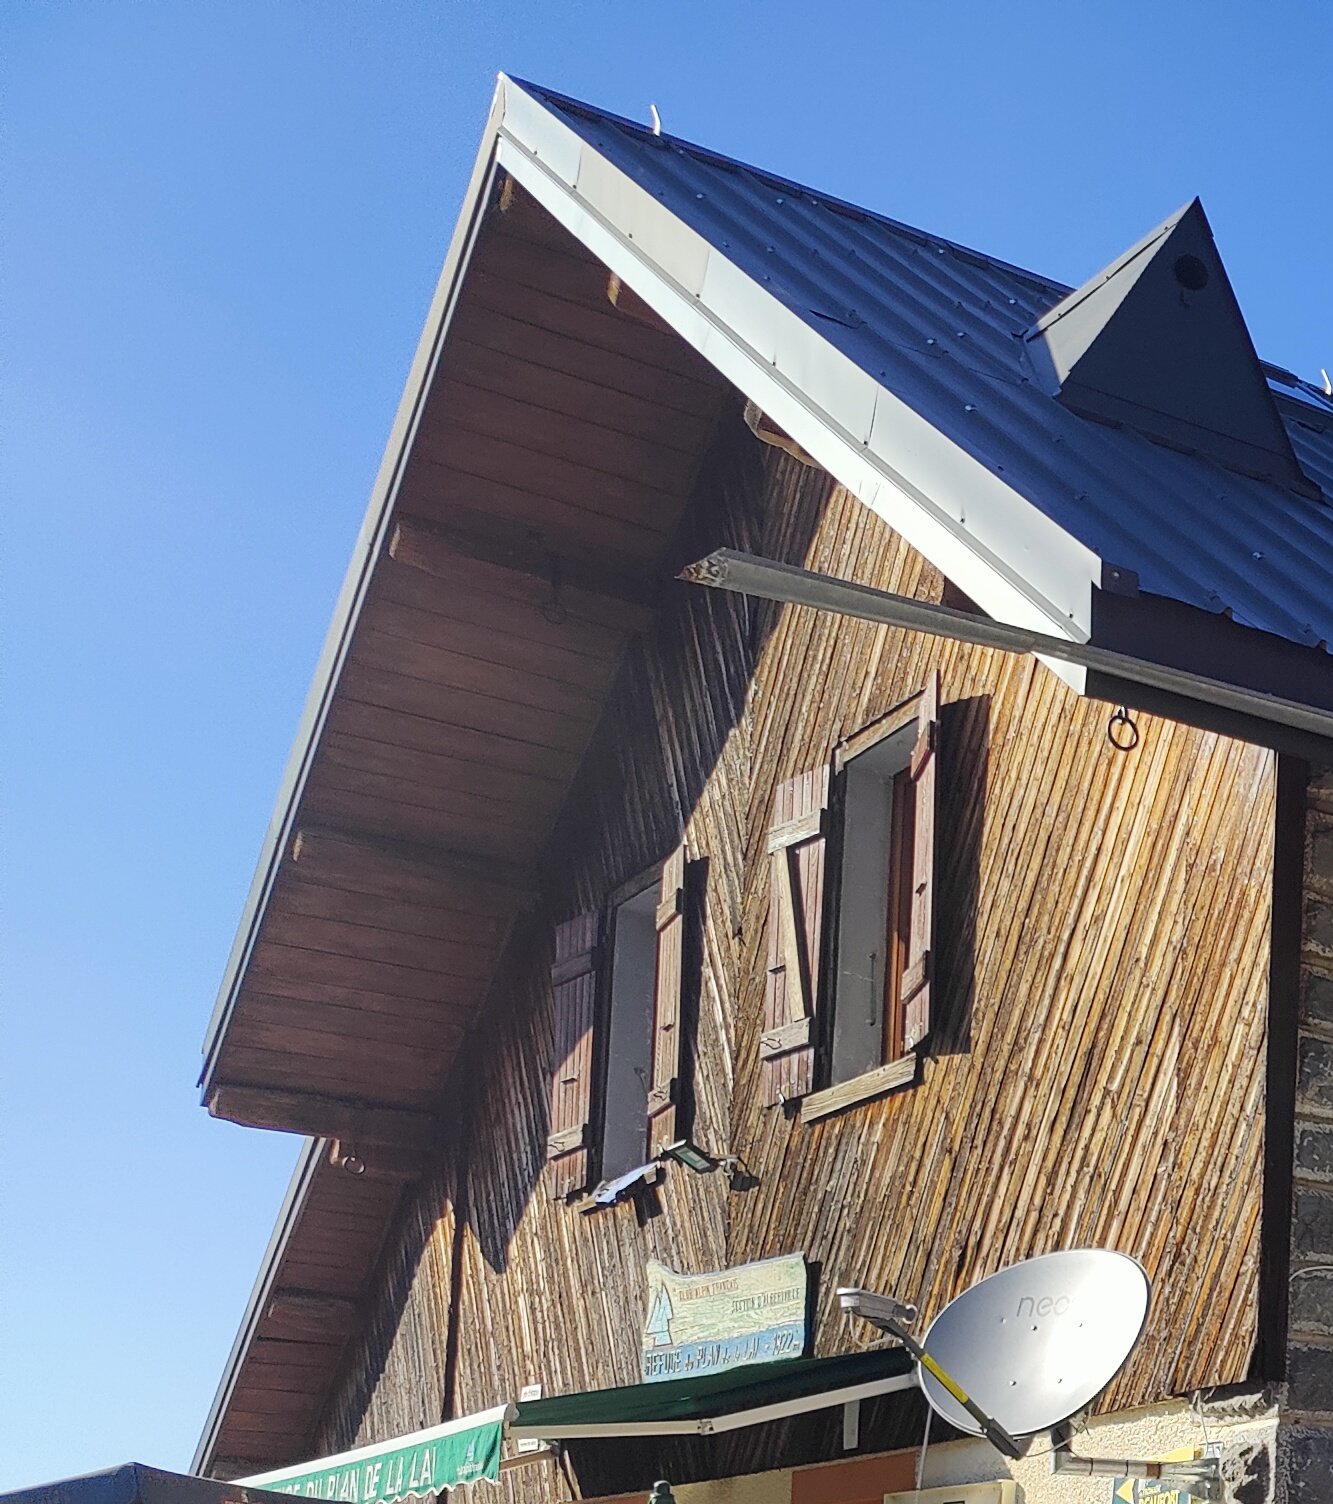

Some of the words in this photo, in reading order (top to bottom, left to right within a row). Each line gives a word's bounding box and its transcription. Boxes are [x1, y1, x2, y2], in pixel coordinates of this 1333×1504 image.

[644, 1350, 682, 1376] REFUGE
[697, 1343, 721, 1368] PLAN
[326, 1468, 359, 1501] PLAN
[364, 1462, 382, 1497] DE
[385, 1456, 404, 1494] LA
[408, 1446, 438, 1489] LAI
